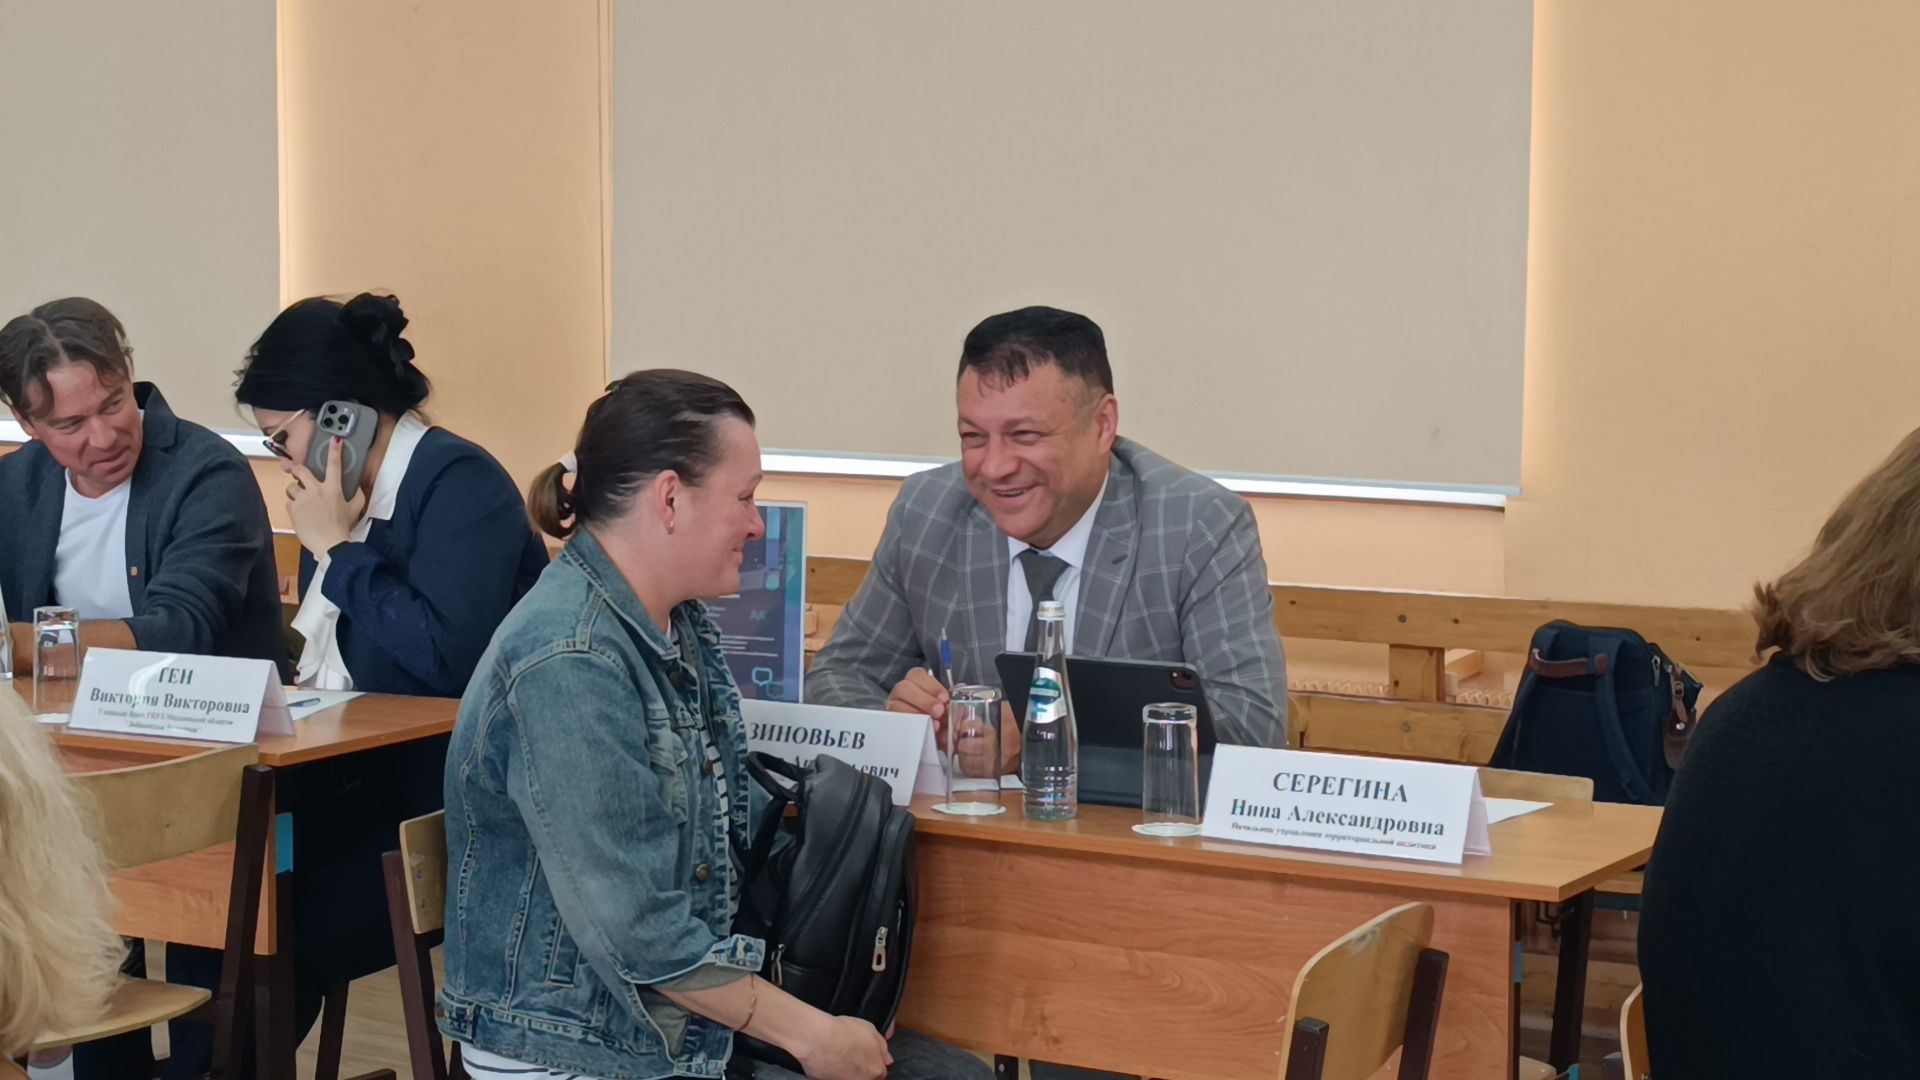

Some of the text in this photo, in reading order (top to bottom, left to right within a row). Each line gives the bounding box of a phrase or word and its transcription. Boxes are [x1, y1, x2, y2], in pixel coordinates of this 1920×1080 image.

[158, 667, 194, 685] ГЕН
[90, 687, 250, 715] Виктория Викторовна
[748, 722, 866, 750] ЗИНОВЬЕВ
[1272, 772, 1408, 803] СЕРЕГИНА
[1230, 799, 1444, 836] Нина Александровна
